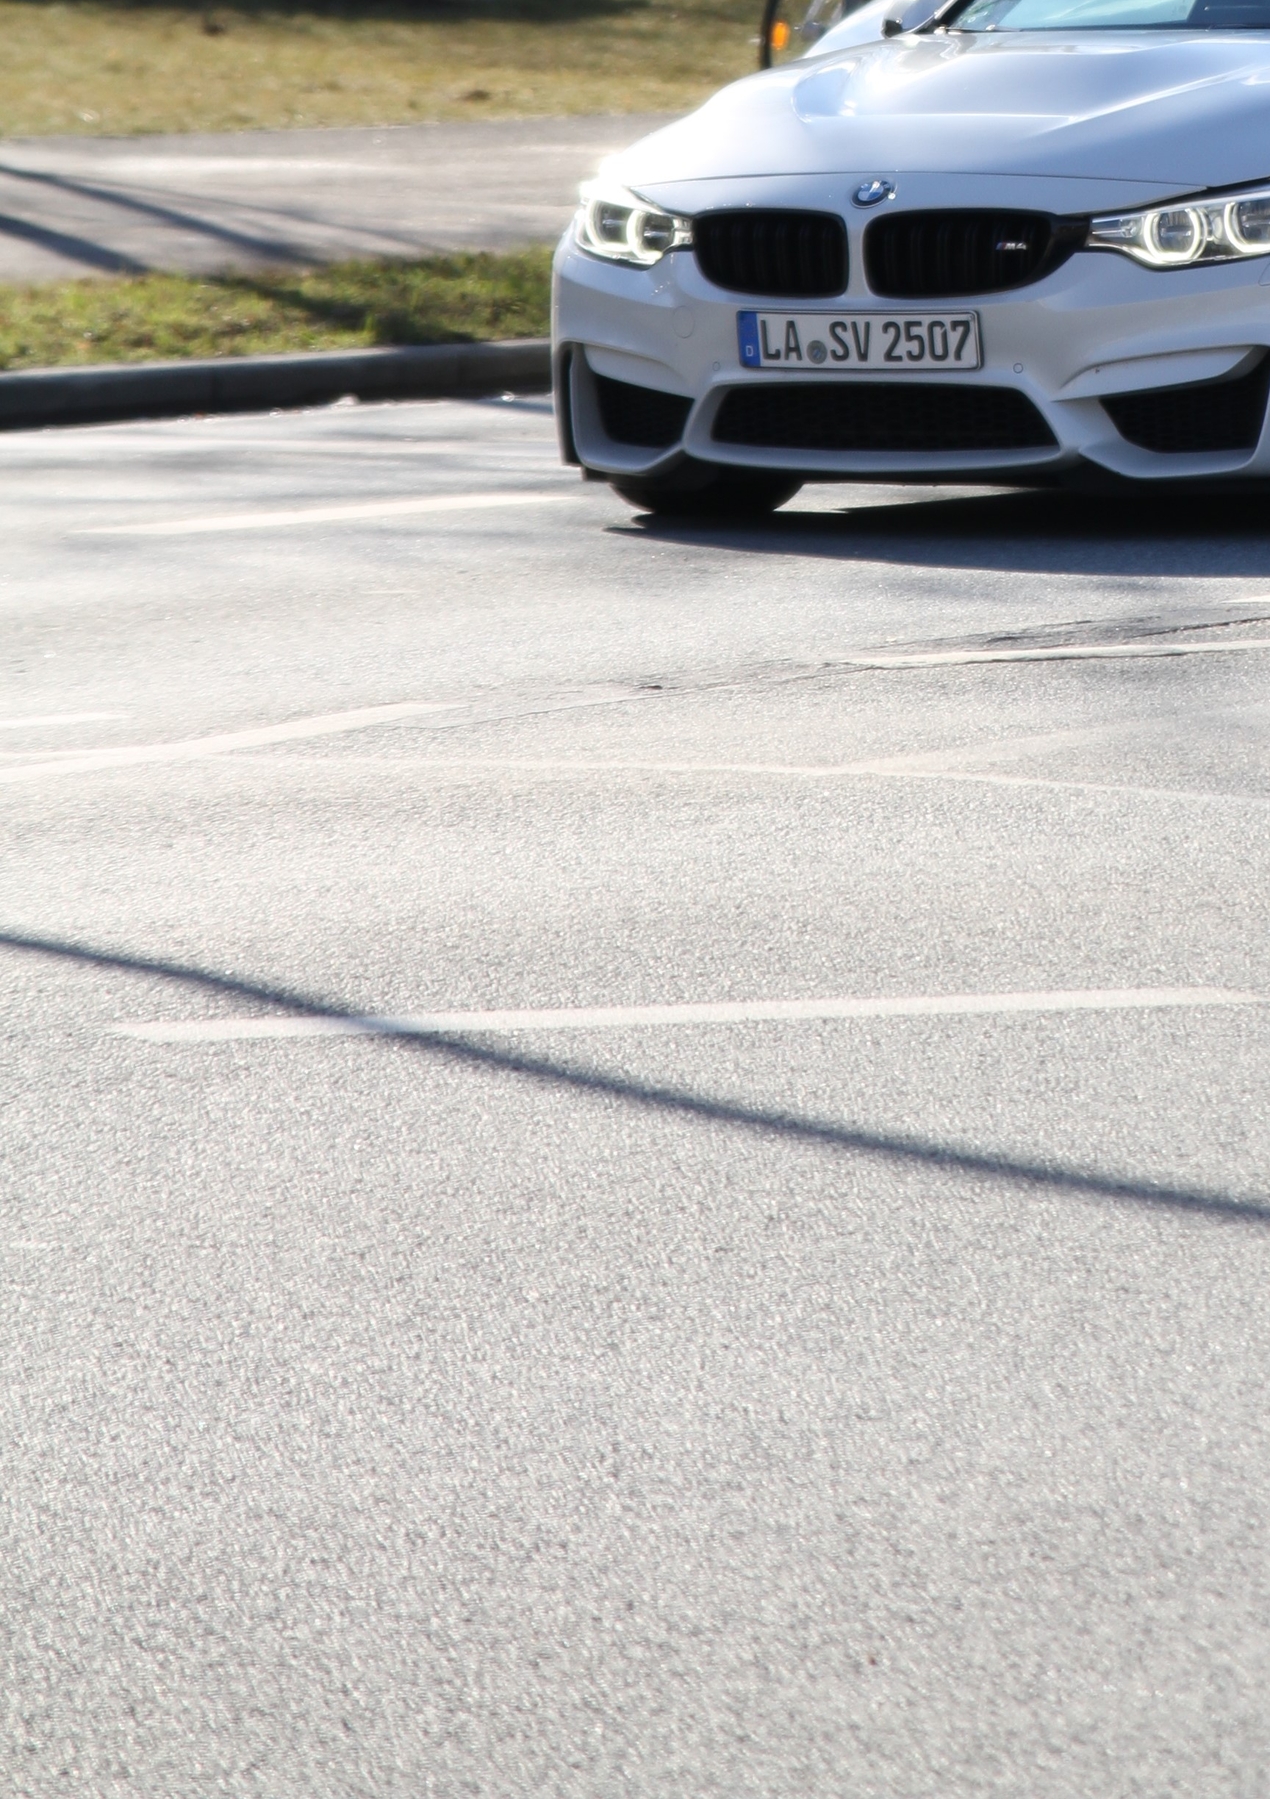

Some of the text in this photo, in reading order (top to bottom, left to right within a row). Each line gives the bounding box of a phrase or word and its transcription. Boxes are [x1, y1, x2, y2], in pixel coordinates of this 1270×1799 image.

[746, 345, 754, 357] D
[760, 319, 970, 362] LA SV 2507
